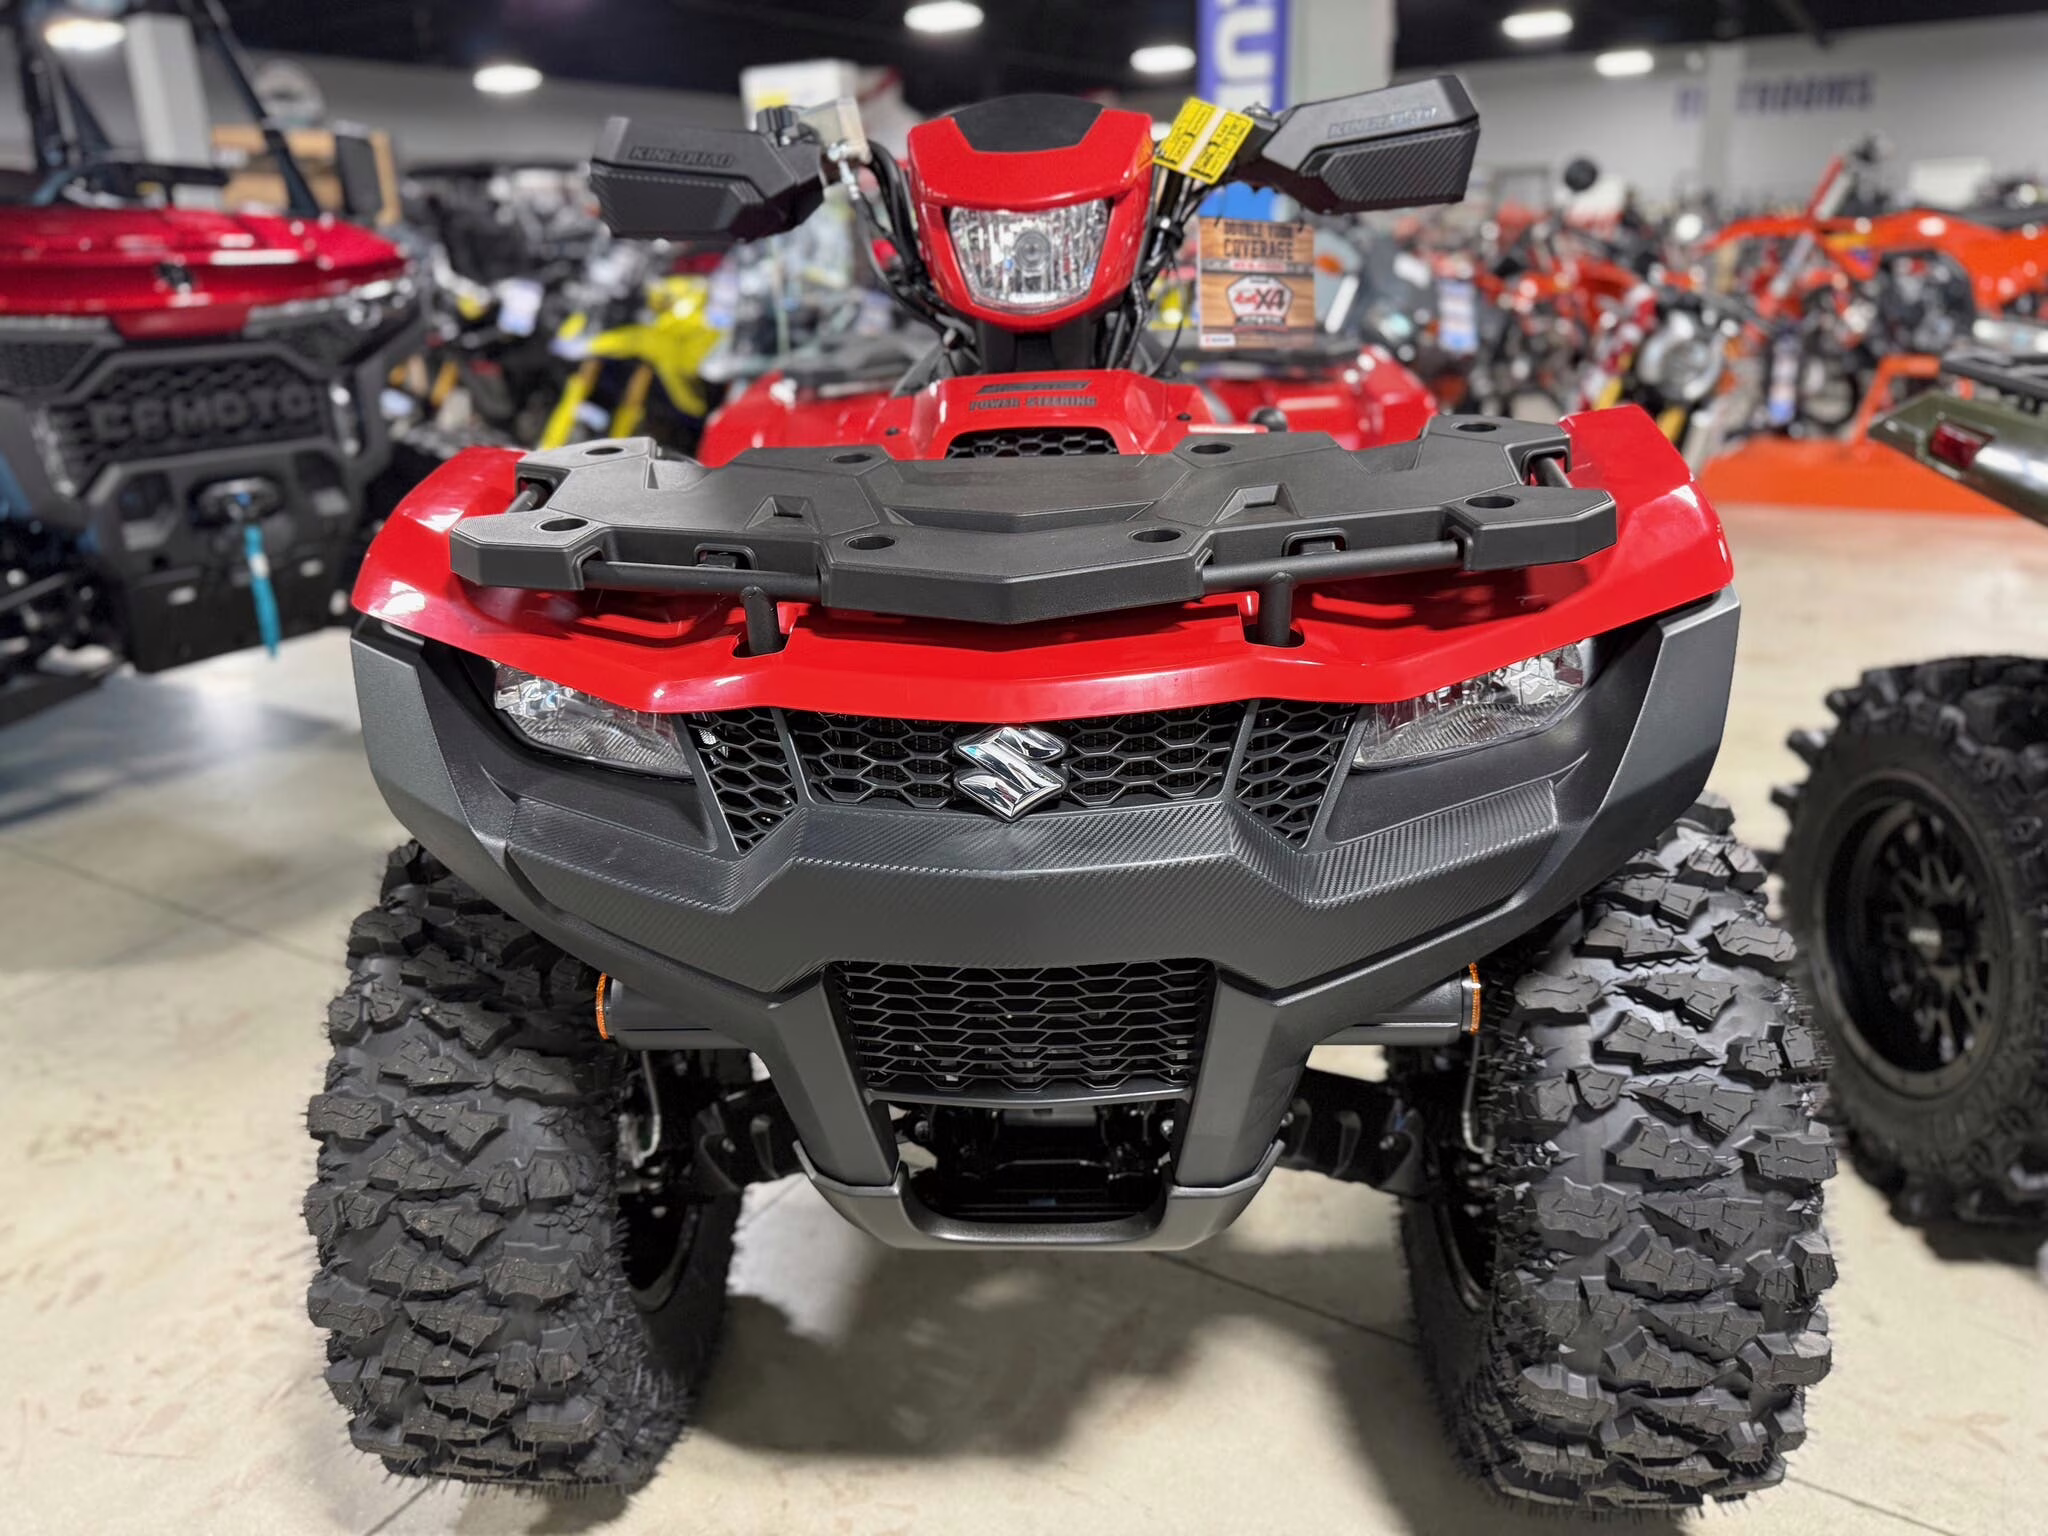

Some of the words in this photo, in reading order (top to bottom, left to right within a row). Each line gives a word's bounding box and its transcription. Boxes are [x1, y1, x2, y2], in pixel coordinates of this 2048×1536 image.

[1223, 238, 1294, 261] COVERAGE
[970, 397, 1020, 412] POWER
[1026, 395, 1097, 408] STEERING
